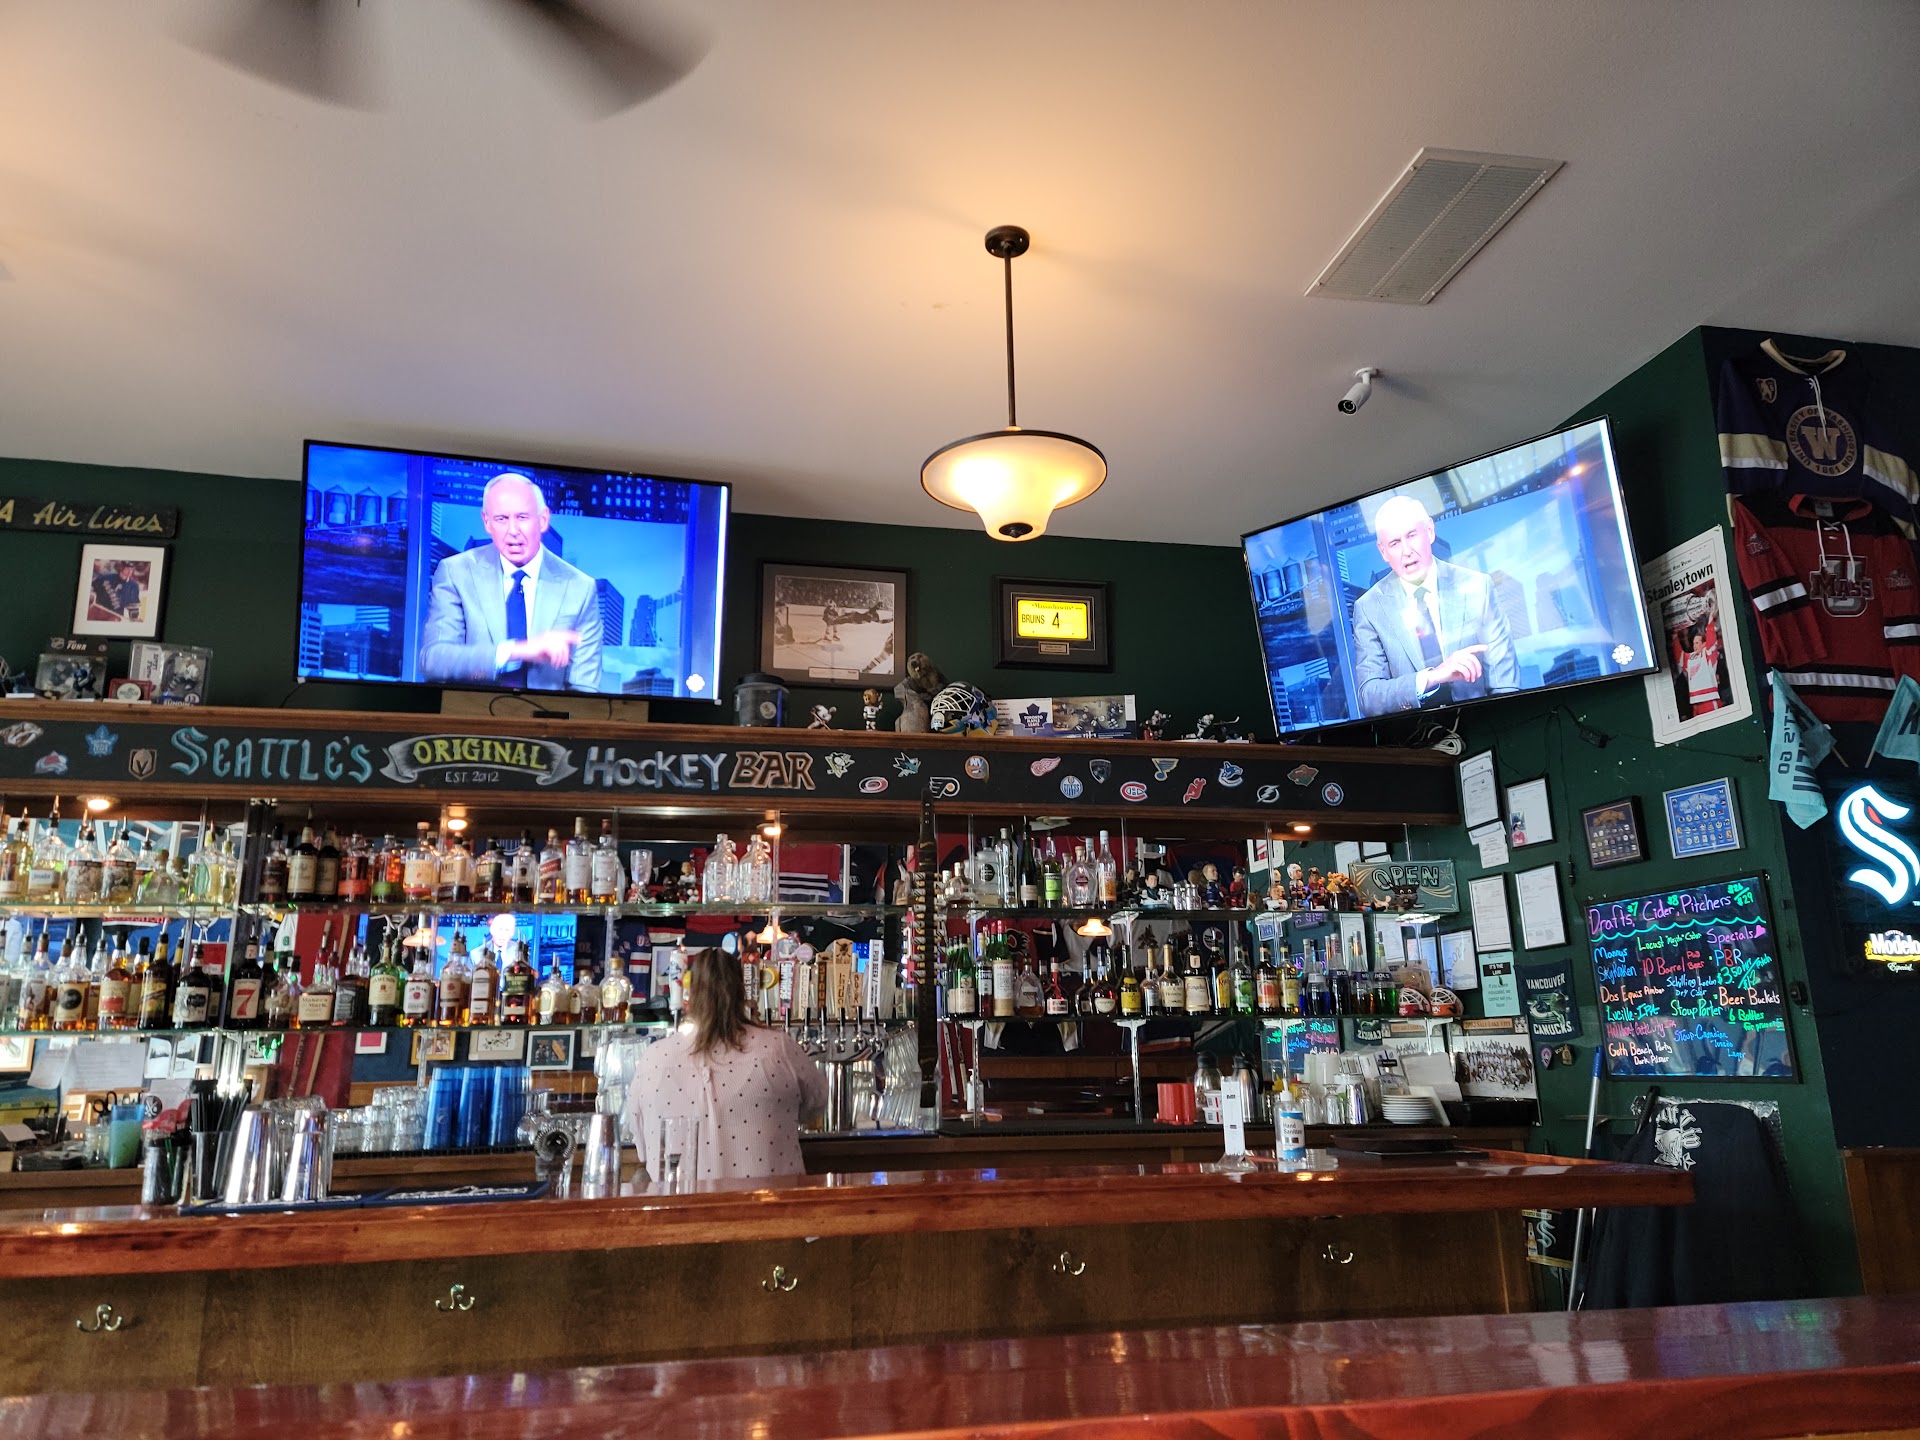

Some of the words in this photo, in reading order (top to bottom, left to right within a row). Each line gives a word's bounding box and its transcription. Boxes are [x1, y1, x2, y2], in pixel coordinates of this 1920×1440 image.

[33, 501, 82, 527] Air
[88, 506, 163, 532] Lines
[1645, 563, 1714, 603] Stanleytown
[1021, 613, 1046, 625] BRUINS
[1052, 611, 1060, 629] 4
[170, 726, 374, 784] SEATTLE'S
[413, 738, 548, 770] ORIGINAL
[728, 751, 816, 790] BAR
[472, 771, 499, 783] 2012
[1372, 866, 1439, 891] OPEN
[1680, 893, 1731, 914] Pitchers
[1637, 936, 1664, 951] Locust
[1706, 928, 1754, 950] Specials
[1869, 932, 1920, 955] Modelo
[1657, 957, 1685, 976] Barrel
[1714, 949, 1744, 968] PBR
[1526, 973, 1566, 990] VANCOUVER
[236, 989, 256, 1016] 7
[1600, 985, 1620, 1004] Dos
[1622, 985, 1643, 1006] Equis
[1719, 986, 1745, 1007] Beer
[1748, 986, 1781, 1006] Buckets
[1533, 1020, 1573, 1036] CANUCKS
